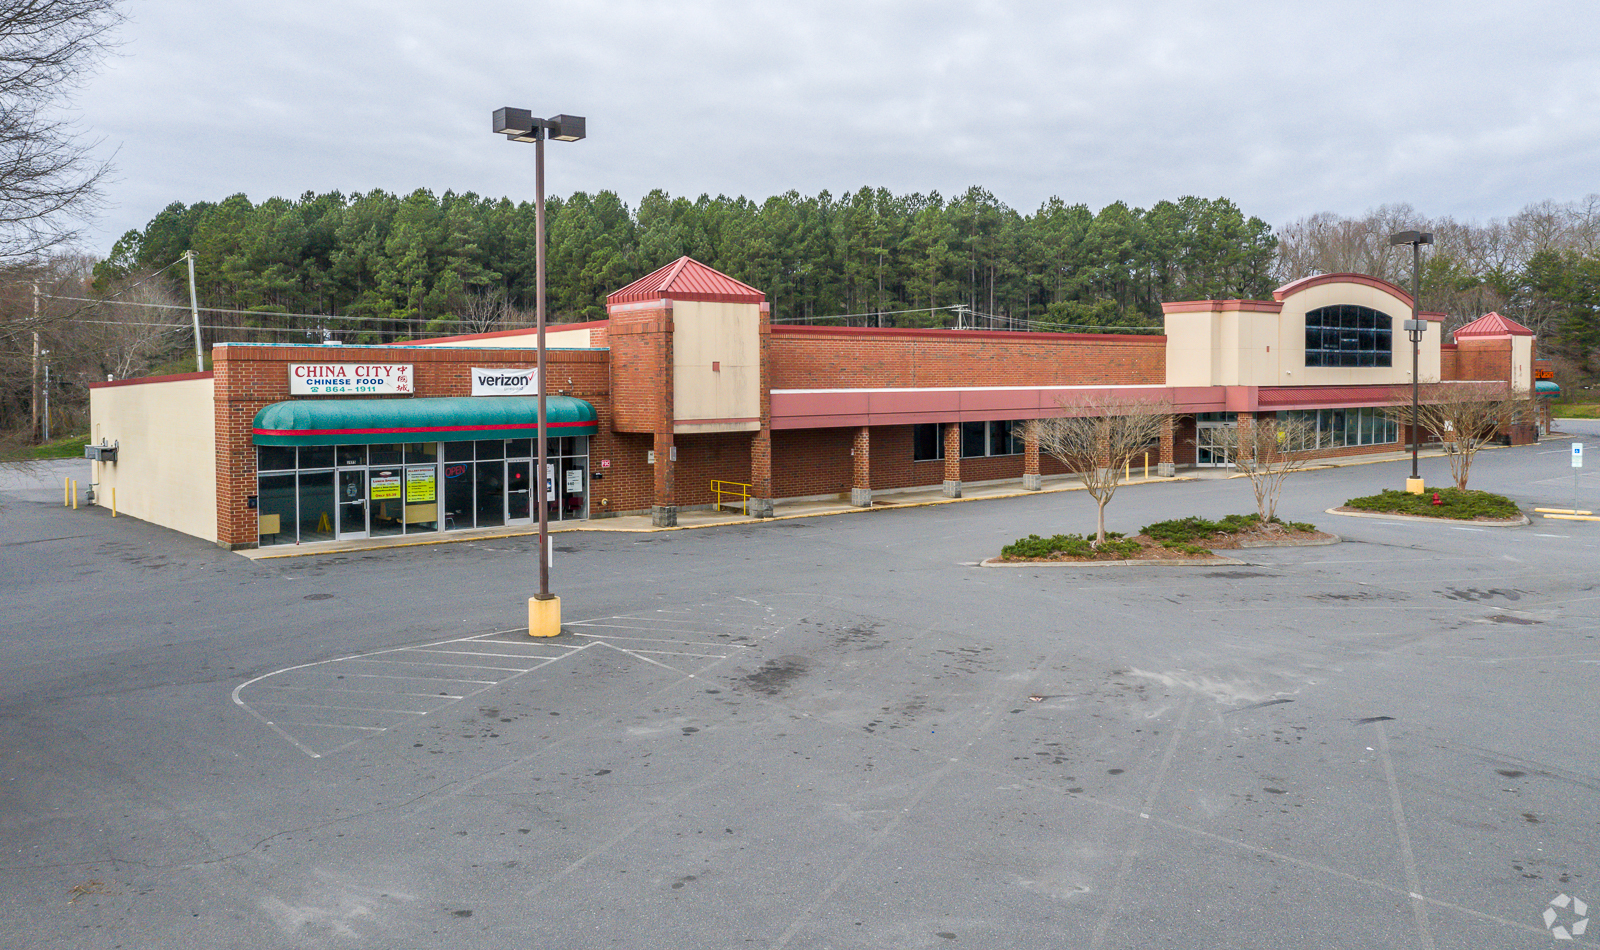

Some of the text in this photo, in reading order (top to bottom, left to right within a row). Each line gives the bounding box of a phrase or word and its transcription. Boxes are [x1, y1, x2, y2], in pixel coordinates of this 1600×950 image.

[294, 365, 393, 378] CHINA CITY
[478, 373, 529, 386] verizon
[445, 465, 466, 477] OPEN
